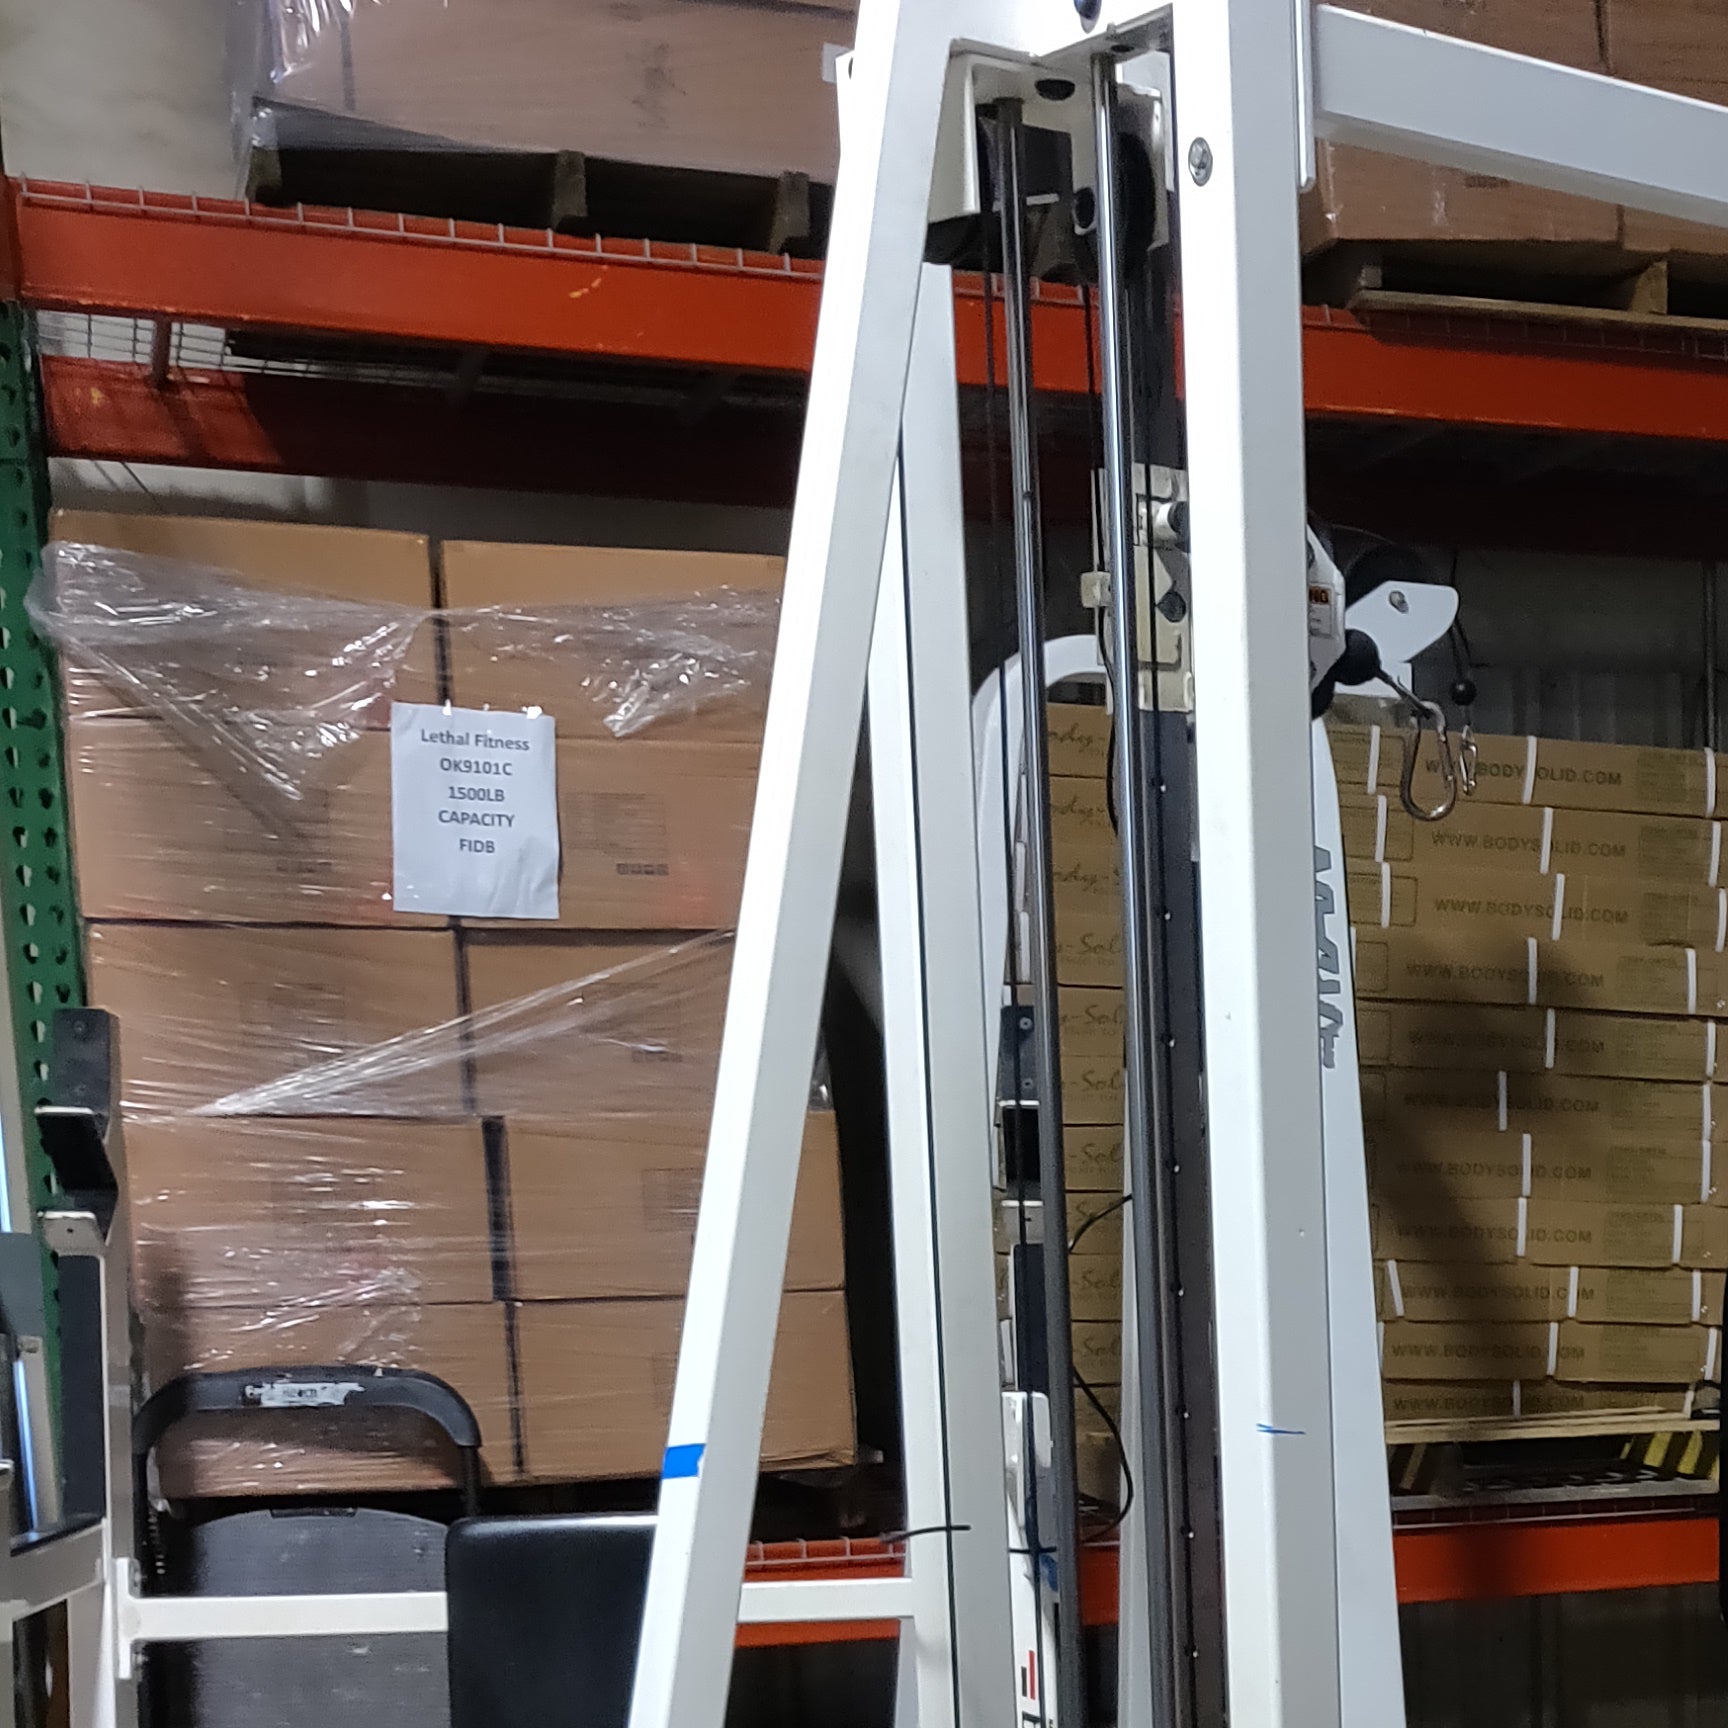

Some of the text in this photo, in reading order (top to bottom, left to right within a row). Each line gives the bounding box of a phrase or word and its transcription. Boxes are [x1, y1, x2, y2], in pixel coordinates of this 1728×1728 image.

[420, 729, 530, 751] Lethal Fitness
[439, 757, 513, 776] OK9101C
[448, 786, 505, 802] 1500LB
[438, 809, 515, 828] CAPACITY
[459, 838, 495, 854] FIDB
[1432, 830, 1627, 857] WWW.BODYSLID.COM
